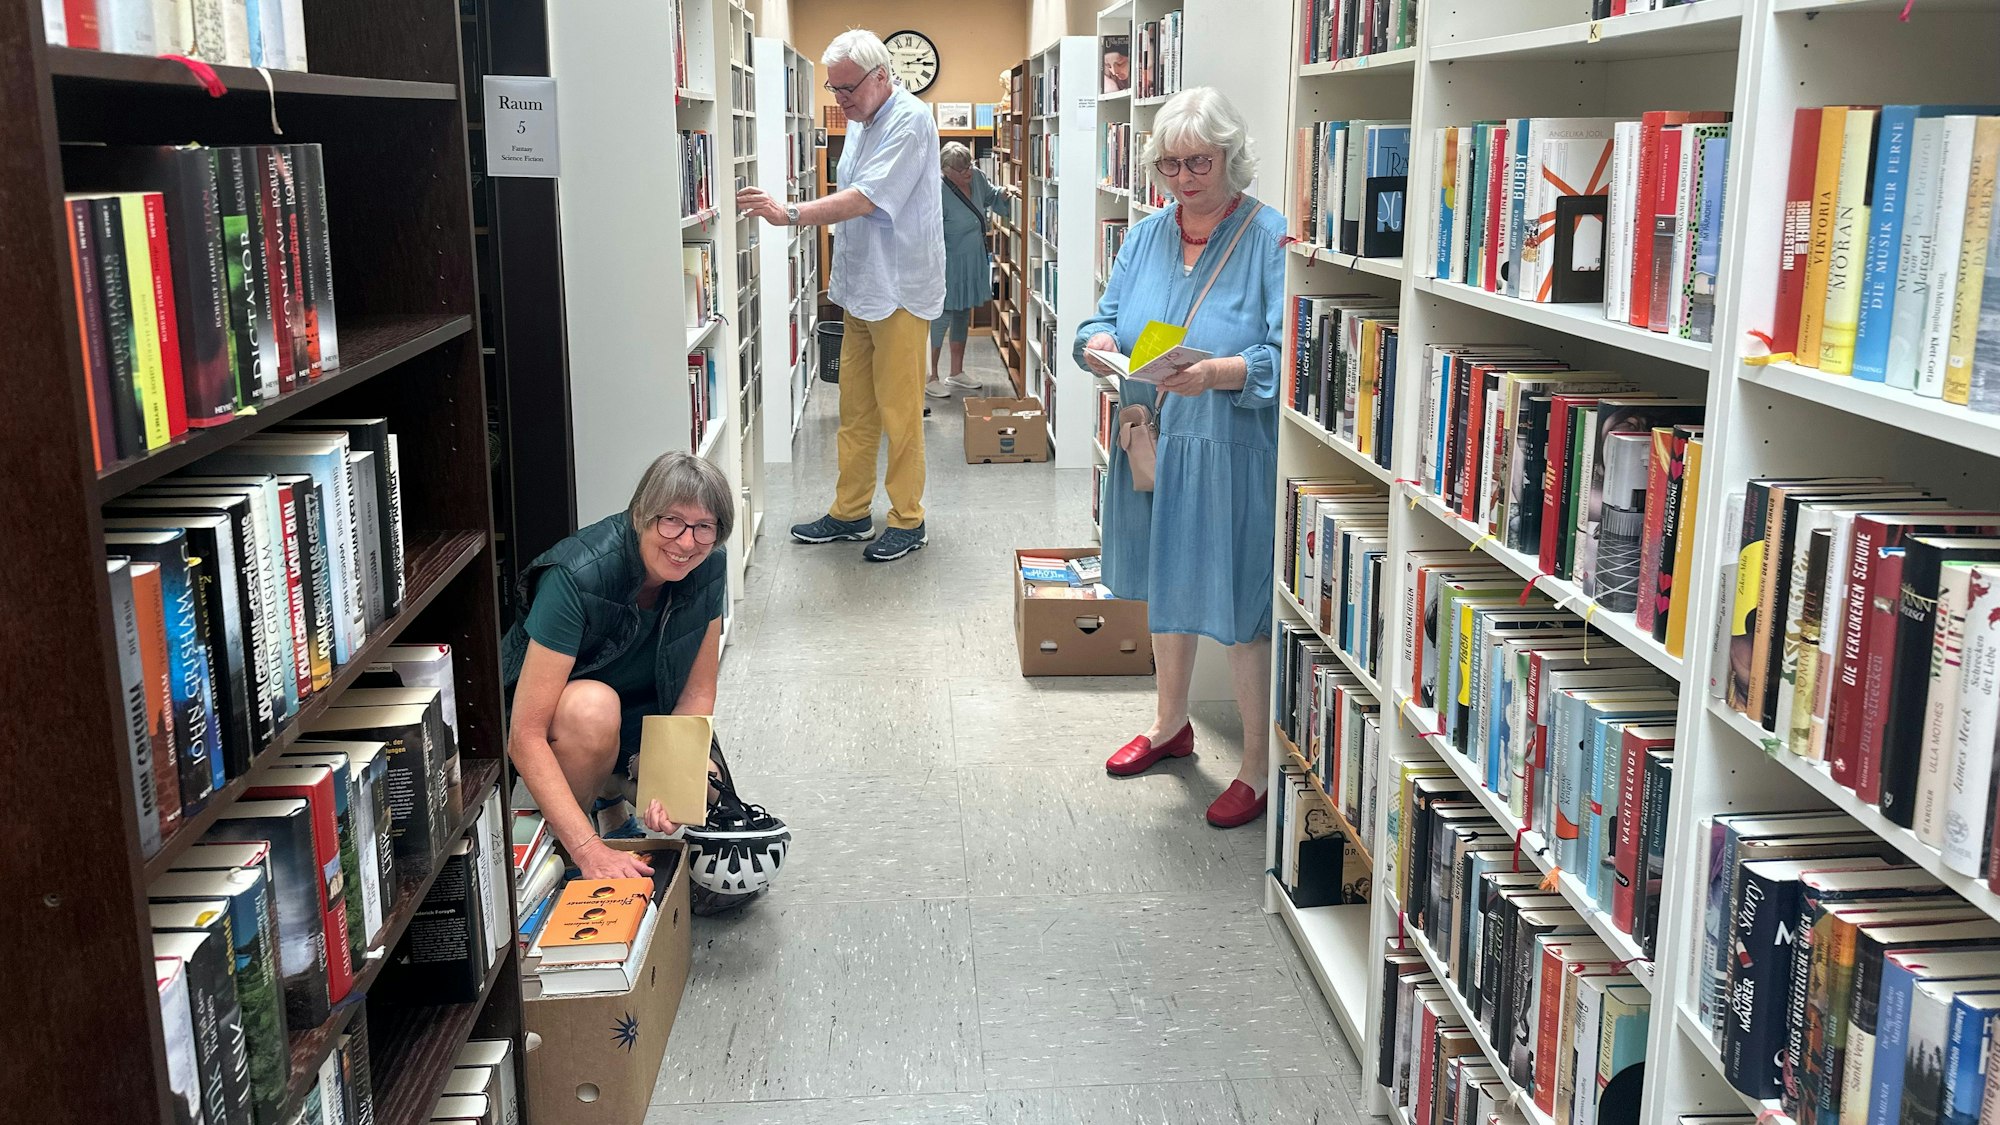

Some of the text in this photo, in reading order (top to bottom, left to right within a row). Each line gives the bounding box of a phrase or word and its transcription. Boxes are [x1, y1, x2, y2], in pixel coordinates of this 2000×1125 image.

[1590, 25, 1598, 39] K
[498, 95, 544, 111] Raum
[517, 120, 526, 134] 5
[1550, 129, 1586, 138] ANGELIKA
[1834, 204, 1853, 291] MORAN
[1897, 233, 1912, 293] Micaela
[1853, 531, 1869, 580] SCHUHE
[1845, 582, 1866, 660] VERLORENEN
[1843, 663, 1857, 686] DIE
[1622, 749, 1636, 845] NACHTBLENDE
[566, 896, 634, 907] Pfirsichsommer
